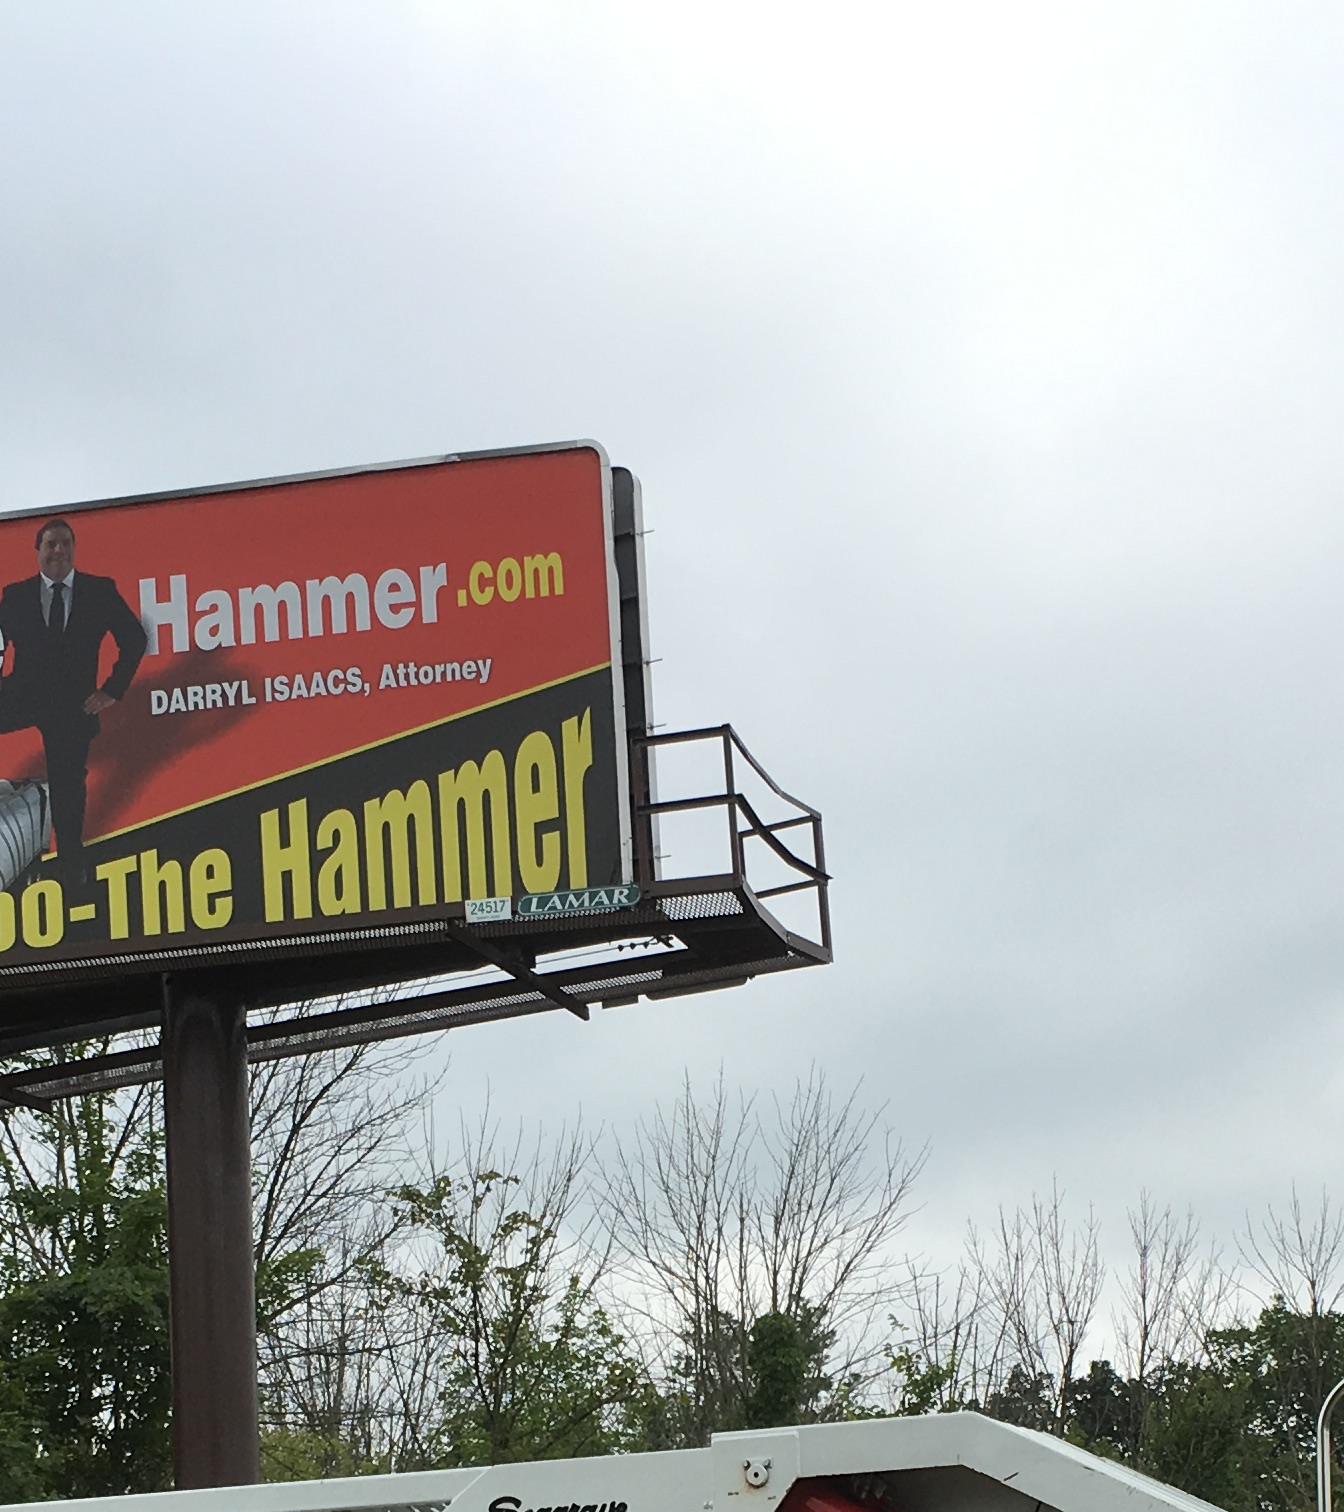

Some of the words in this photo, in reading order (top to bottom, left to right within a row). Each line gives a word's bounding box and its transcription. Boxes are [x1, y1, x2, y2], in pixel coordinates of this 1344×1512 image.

[151, 681, 256, 716] DARRYL
[264, 667, 370, 701] ISAACS,
[378, 657, 492, 692] Attorney
[260, 706, 592, 923] Hammer
[471, 900, 506, 915] 24517
[530, 888, 629, 912] LAMAR
